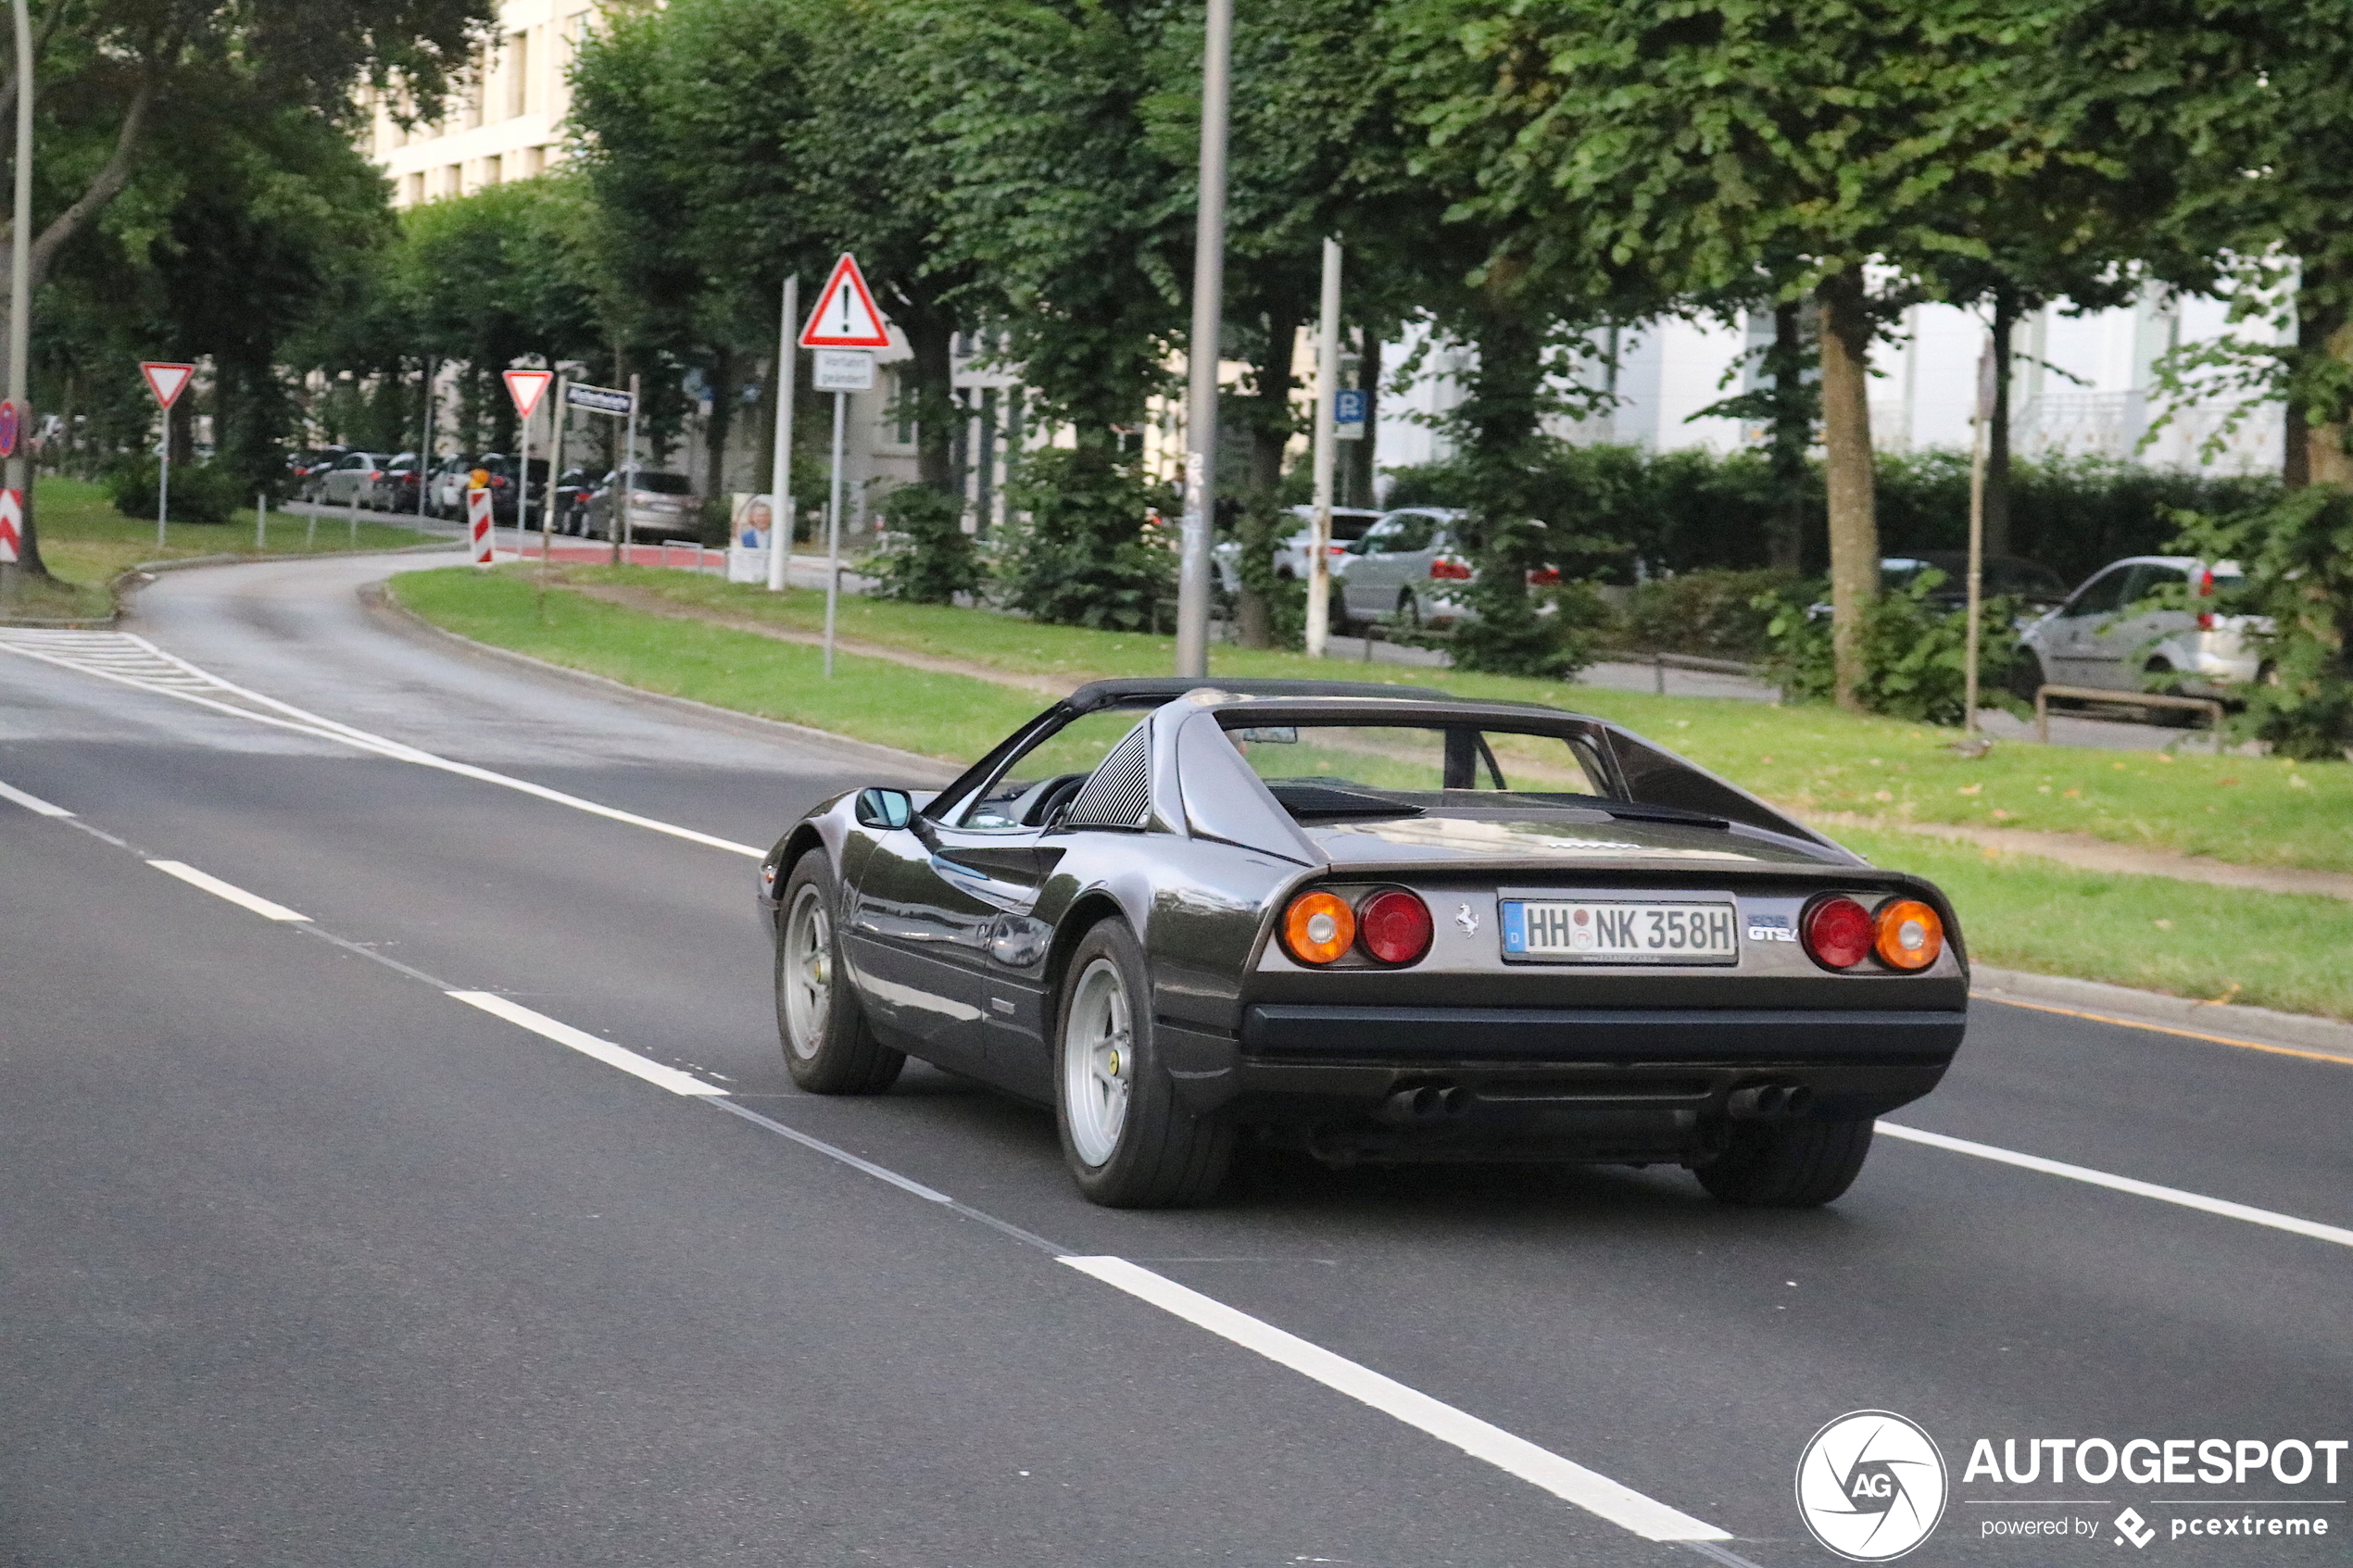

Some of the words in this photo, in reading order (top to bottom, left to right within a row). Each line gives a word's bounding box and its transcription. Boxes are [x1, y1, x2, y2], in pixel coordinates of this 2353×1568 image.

[1510, 932, 1519, 944] D
[1527, 909, 1570, 947] HH
[1595, 909, 1639, 948] NK
[1646, 910, 1730, 950] 358H
